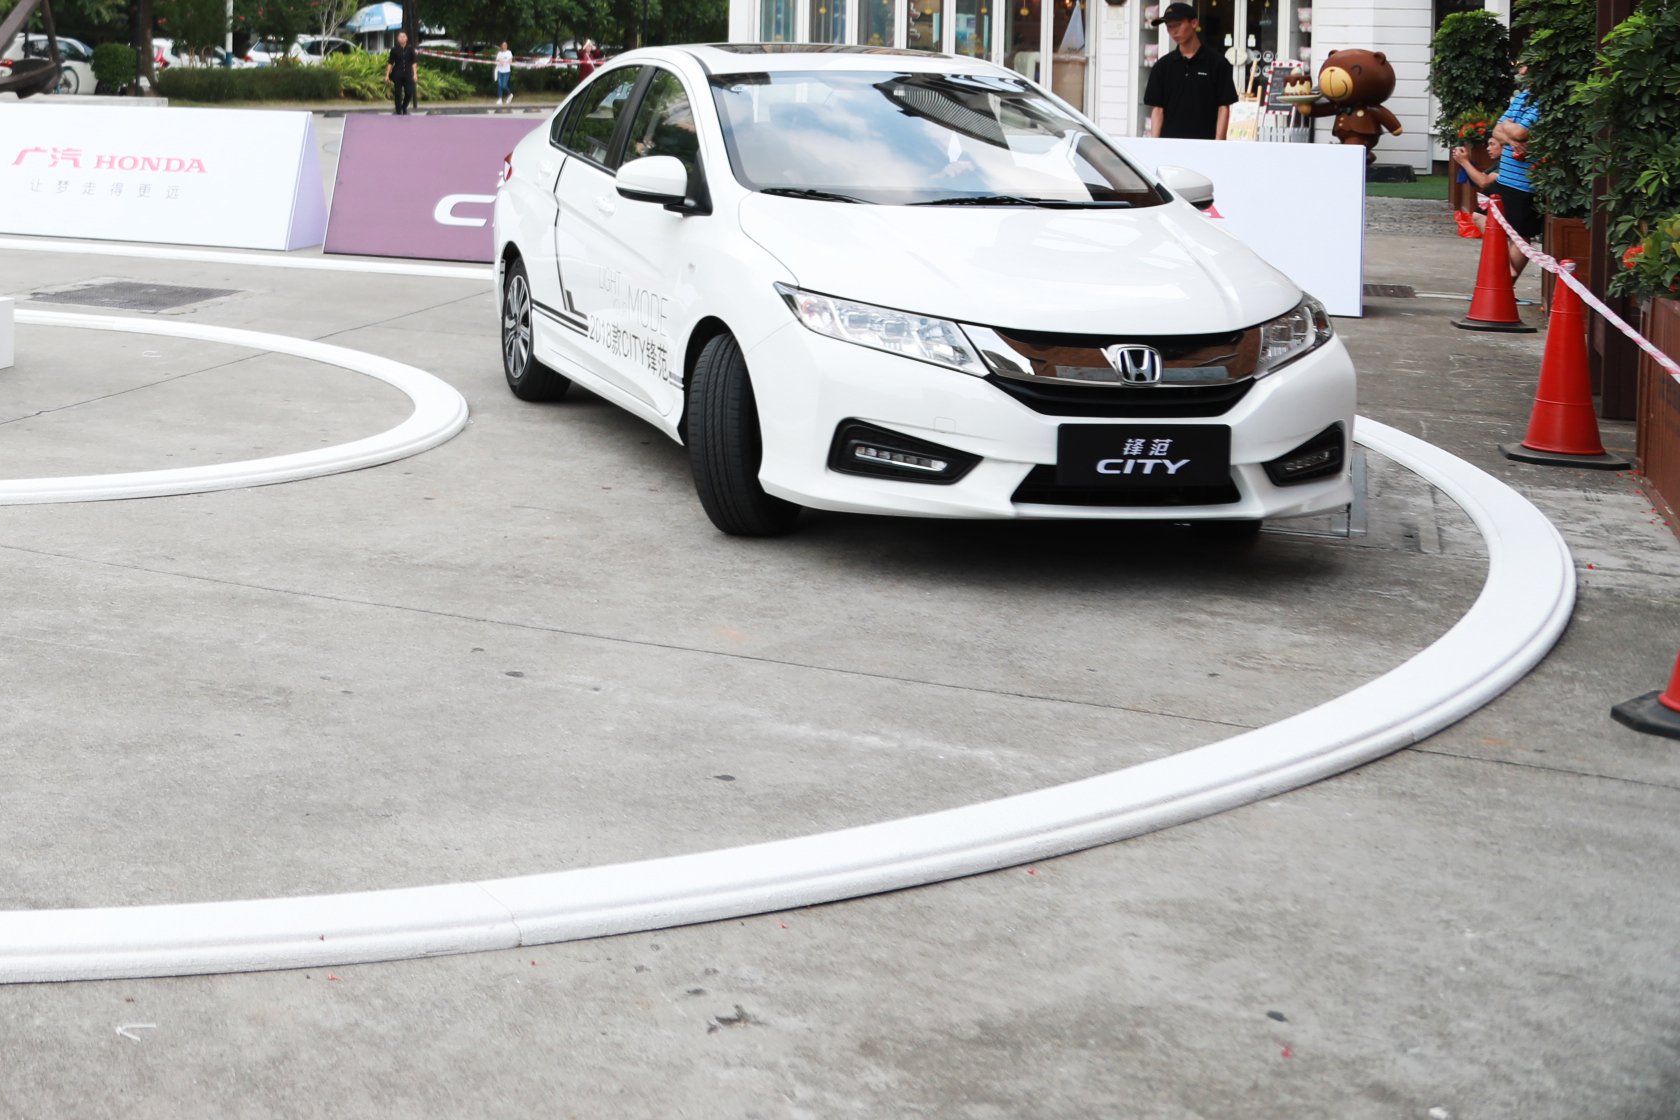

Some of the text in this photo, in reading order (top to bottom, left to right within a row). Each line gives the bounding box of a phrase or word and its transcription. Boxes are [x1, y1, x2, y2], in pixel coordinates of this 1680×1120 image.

[11, 146, 208, 174] 广汽 HONDA
[30, 178, 180, 200] 让梦走得更远
[599, 266, 622, 295] LIGHT
[627, 284, 668, 338] MODE
[589, 314, 669, 382] 2018款CITY锋范
[1122, 439, 1173, 456] 锋范
[1096, 458, 1191, 475] CITY
